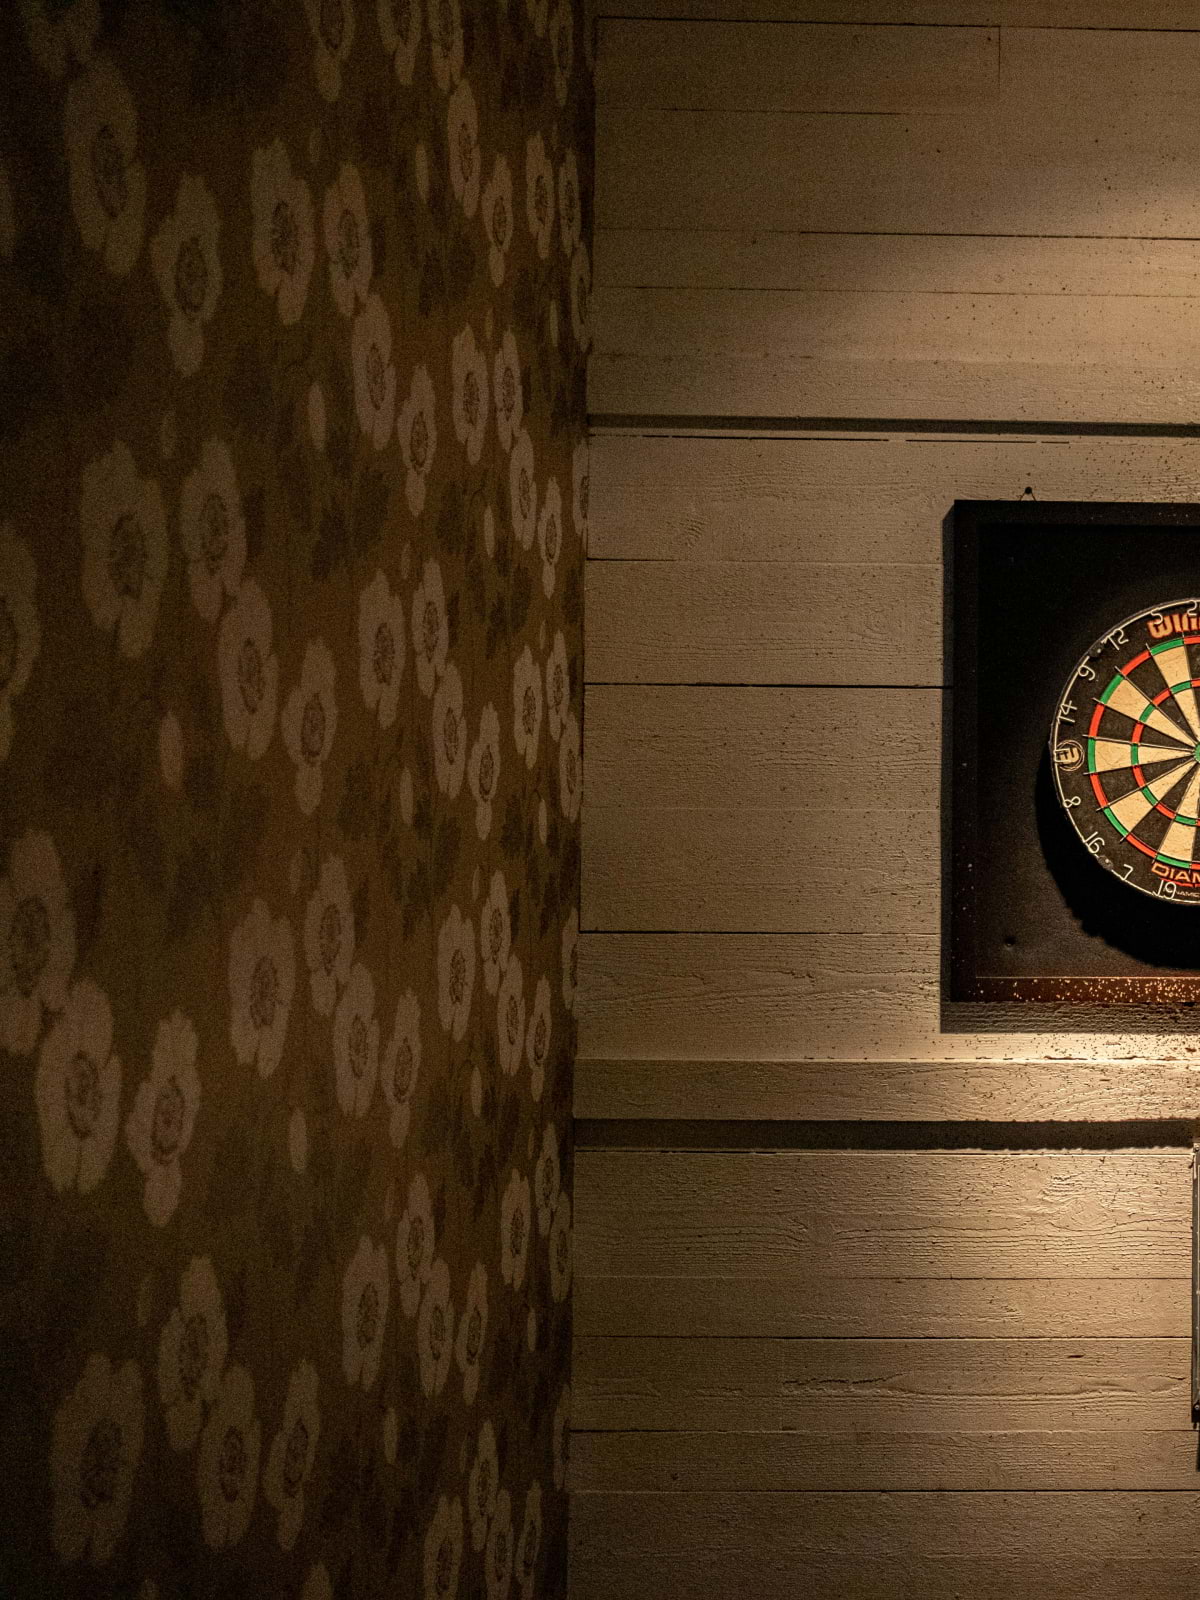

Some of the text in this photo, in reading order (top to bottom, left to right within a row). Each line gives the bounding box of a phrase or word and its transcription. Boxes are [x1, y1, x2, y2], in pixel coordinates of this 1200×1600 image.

[1150, 609, 1164, 625] 5
[1101, 628, 1129, 651] 12
[1077, 664, 1096, 681] 9
[1057, 700, 1078, 725] 14
[1063, 796, 1081, 808] 8
[1082, 831, 1105, 854] 16
[1122, 863, 1134, 881] 7
[1153, 879, 1177, 900] 19
